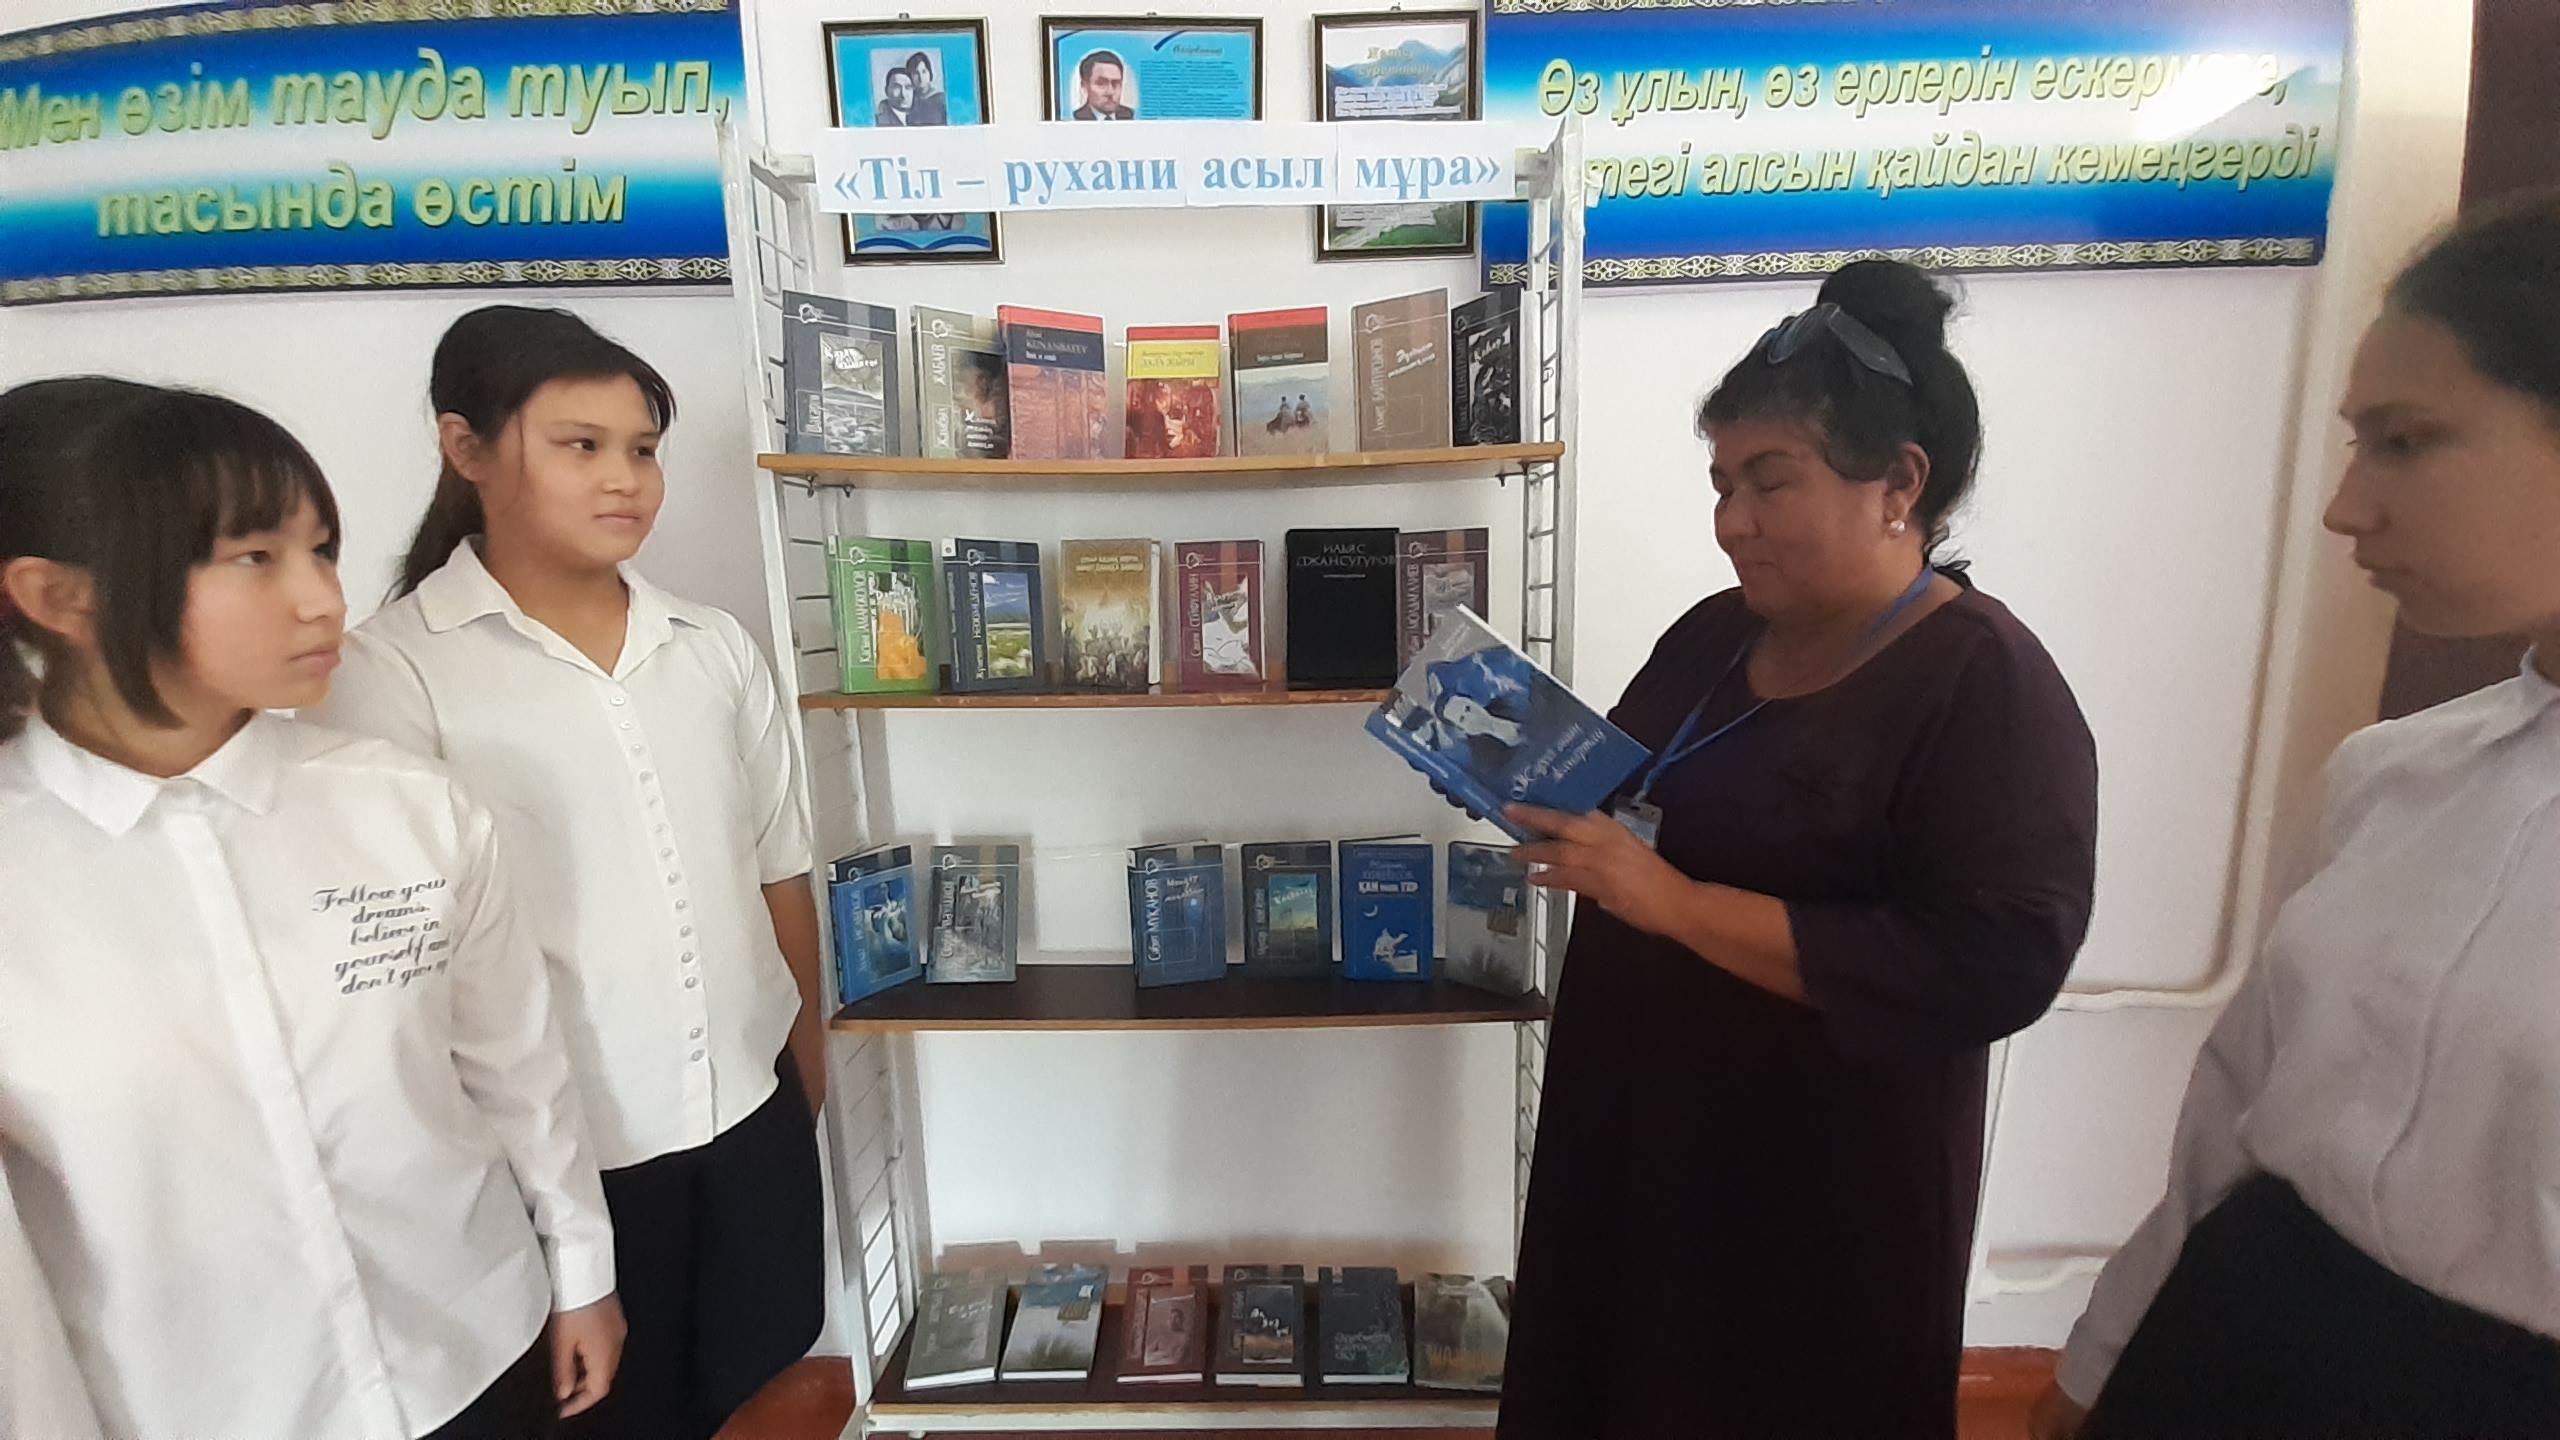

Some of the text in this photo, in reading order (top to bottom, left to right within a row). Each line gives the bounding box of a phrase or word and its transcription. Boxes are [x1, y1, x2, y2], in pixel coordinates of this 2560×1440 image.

[0, 48, 731, 150] Мен өзім тауда туып,
[1540, 58, 1600, 116] Өз
[1611, 67, 1748, 126] ұлын,
[1763, 64, 1818, 109] өз
[1832, 46, 2018, 117] ерлерін
[97, 158, 627, 237] тасында өстім
[835, 156, 941, 202] «Тіл
[1006, 155, 1178, 204] рухани
[1203, 155, 1323, 190] асыл
[1355, 155, 1501, 200] мұра»
[1700, 150, 1853, 196] алсын
[1866, 131, 2030, 200] қайдан
[2052, 123, 2320, 193] кемеңгерді
